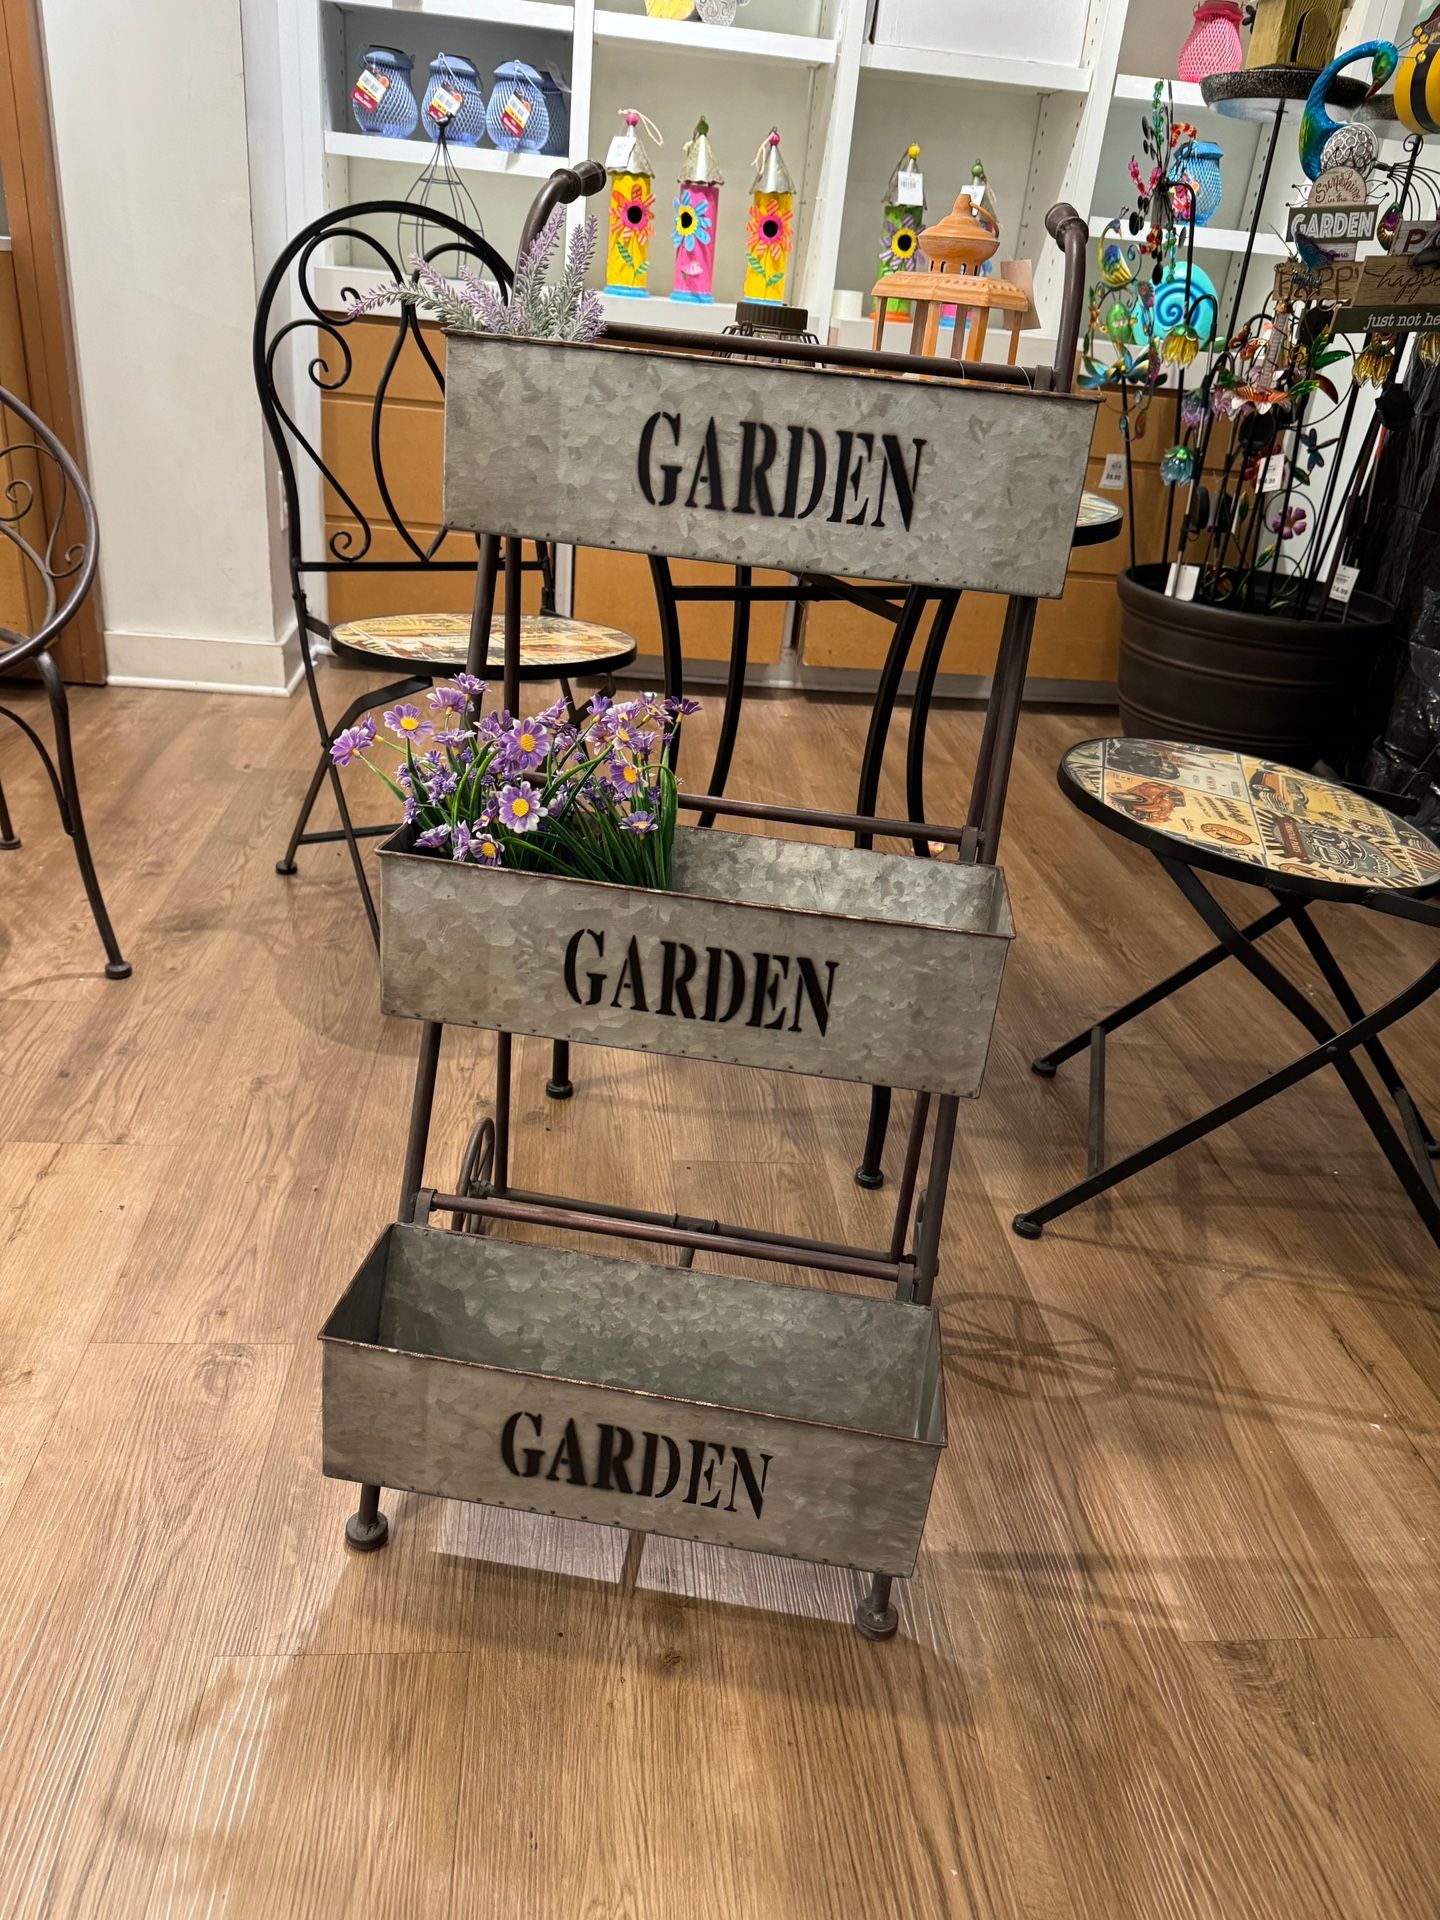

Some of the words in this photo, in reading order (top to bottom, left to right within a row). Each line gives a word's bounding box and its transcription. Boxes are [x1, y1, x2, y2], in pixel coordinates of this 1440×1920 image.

[1315, 171, 1361, 203] Sunshine
[1291, 211, 1375, 238] GARDEN
[1363, 313, 1395, 330] just
[1396, 313, 1421, 326] not
[638, 411, 927, 532] GARDEN
[564, 928, 840, 1037] GARDEN
[500, 1411, 774, 1520] GARDEN
